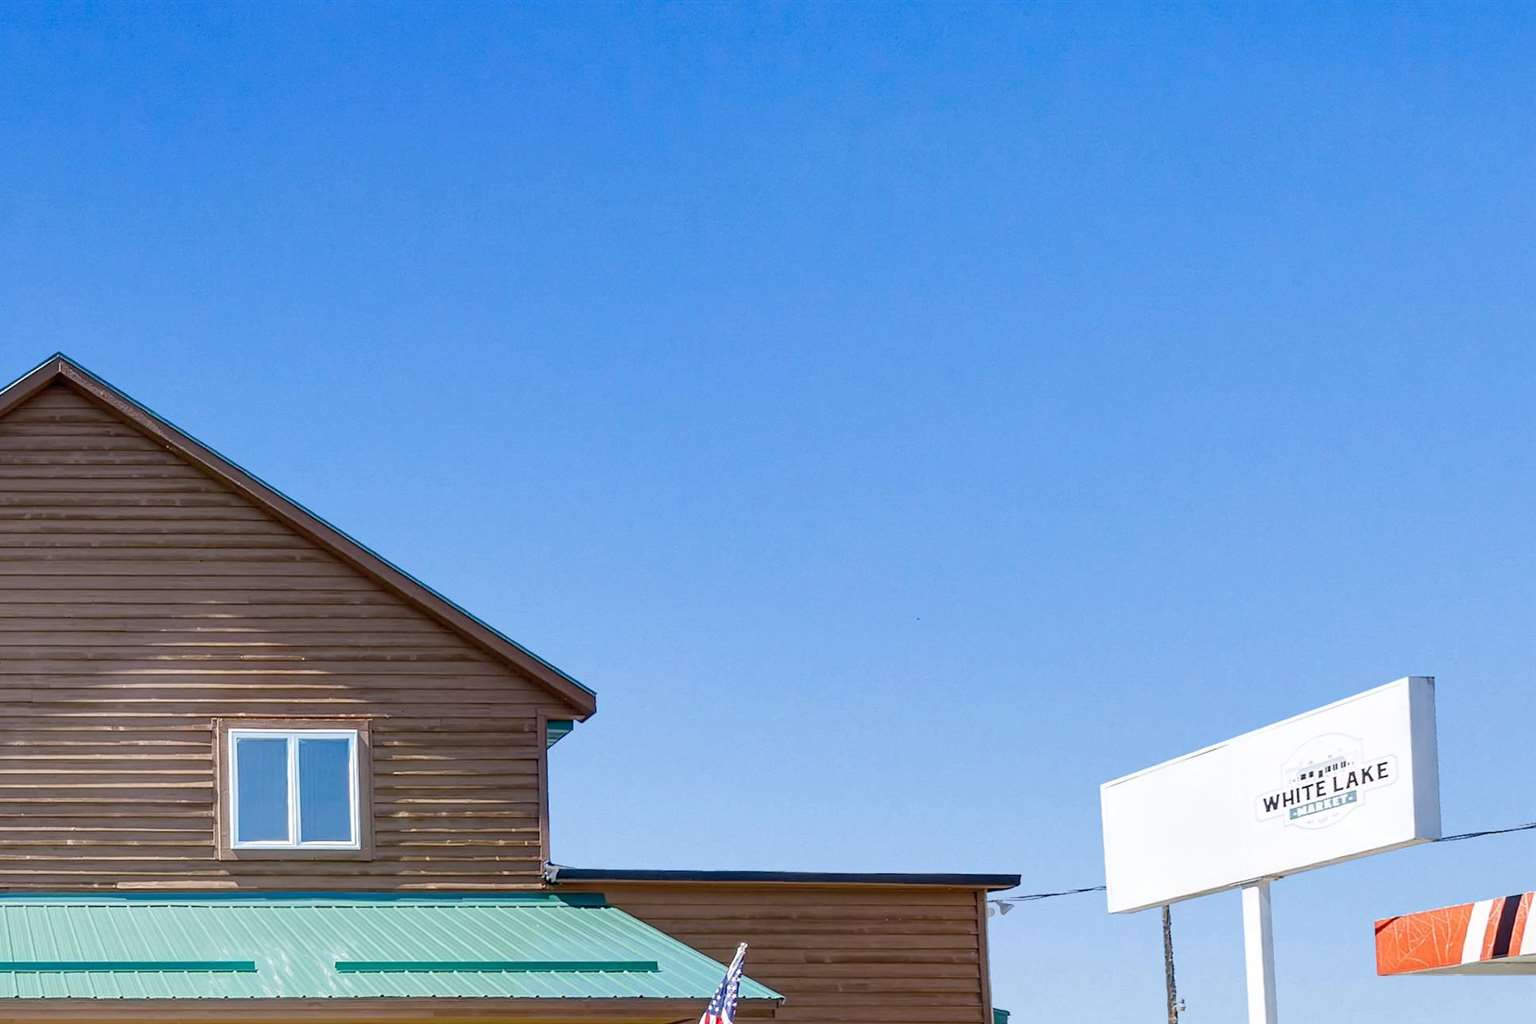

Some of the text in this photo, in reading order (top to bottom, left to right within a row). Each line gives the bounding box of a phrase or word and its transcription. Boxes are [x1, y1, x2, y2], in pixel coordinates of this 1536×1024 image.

[1262, 761, 1389, 813] WHITE LAKE
[1297, 796, 1346, 817] MARKET
